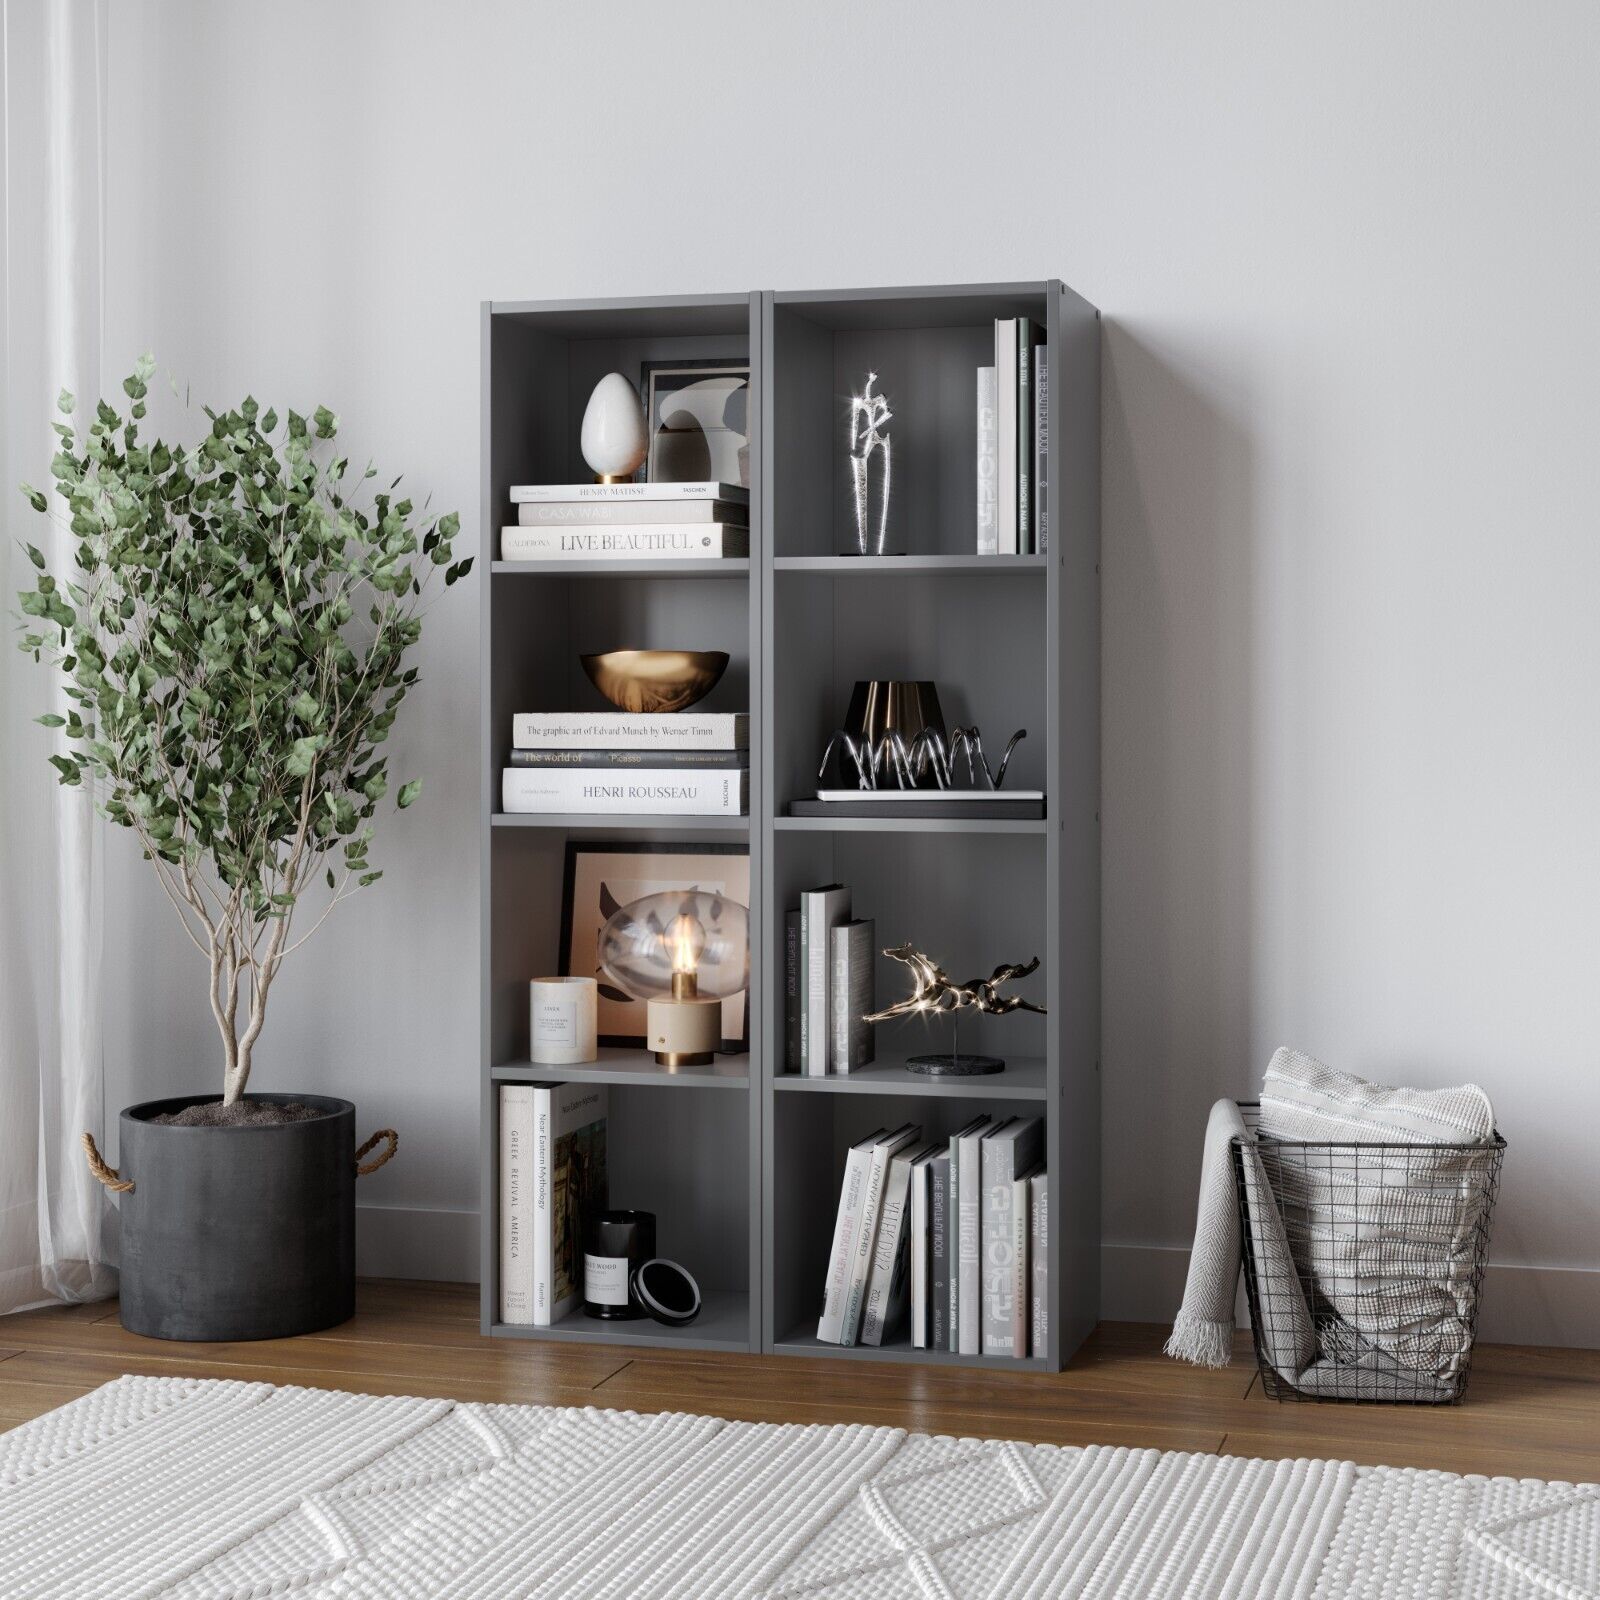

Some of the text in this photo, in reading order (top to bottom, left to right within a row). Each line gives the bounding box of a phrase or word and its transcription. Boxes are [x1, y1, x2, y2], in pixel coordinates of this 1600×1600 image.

[579, 487, 646, 496] HENRY MATISSE
[560, 533, 694, 551] LIVE BEAUTIFUL
[527, 726, 713, 739] The graphic art of Edvard Munch by Werner Timm
[524, 752, 584, 762] The world of
[610, 754, 642, 763] Picasso
[583, 786, 698, 799] HENRI ROUSSEAU
[537, 1113, 547, 1210] Near Eastern Mythology
[510, 1130, 519, 1259] GREEK REVIVAL AMERICA
[537, 1282, 545, 1308] Hamlyn
